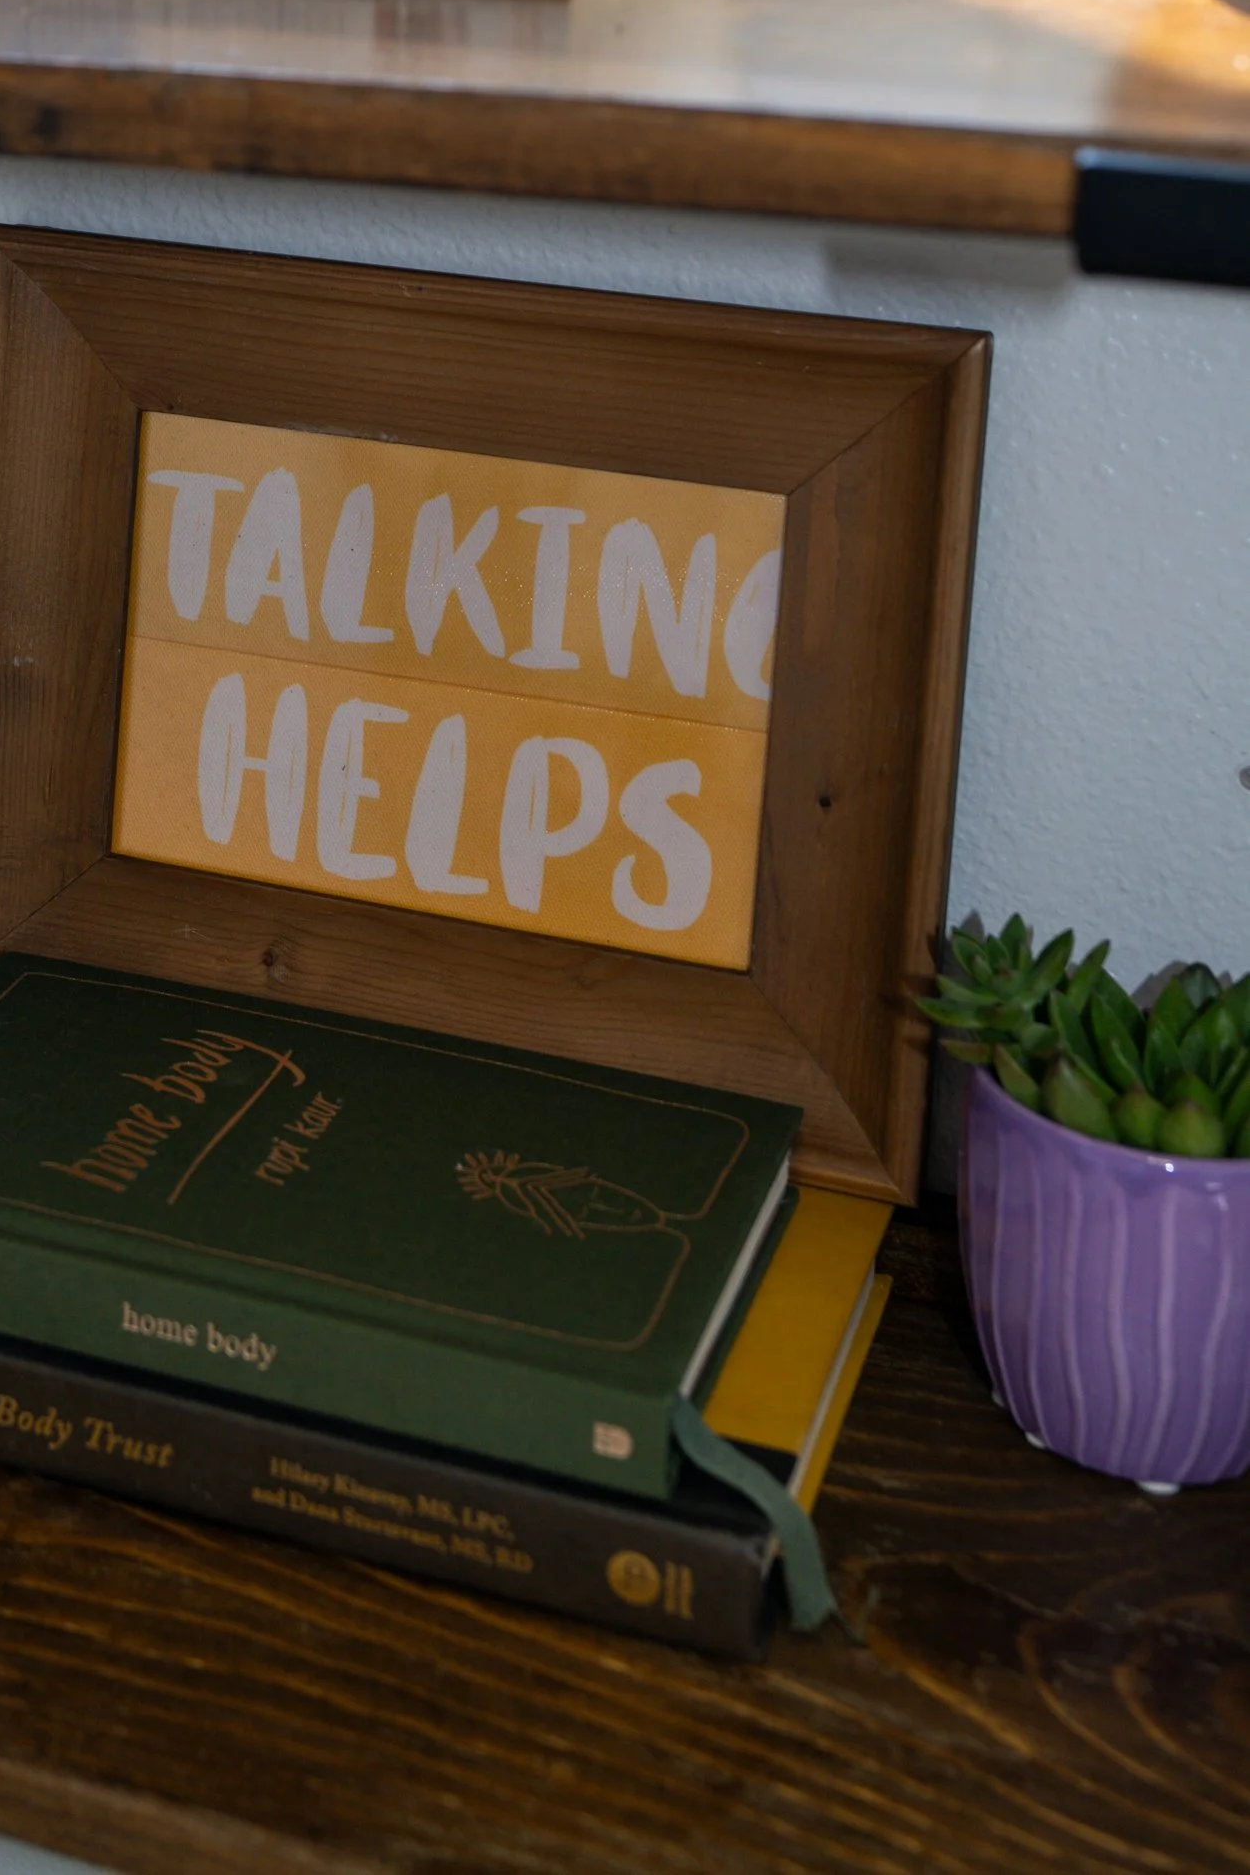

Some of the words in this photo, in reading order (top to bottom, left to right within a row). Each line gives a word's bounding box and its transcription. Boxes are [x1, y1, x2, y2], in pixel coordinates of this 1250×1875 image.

[196, 672, 713, 931] HELPS
[40, 1102, 182, 1193] home
[118, 1028, 306, 1105] body
[253, 1136, 310, 1187] rupi
[283, 1091, 343, 1141] kaur
[121, 1301, 198, 1347] home
[207, 1322, 278, 1371] body
[83, 1417, 174, 1468] Trust
